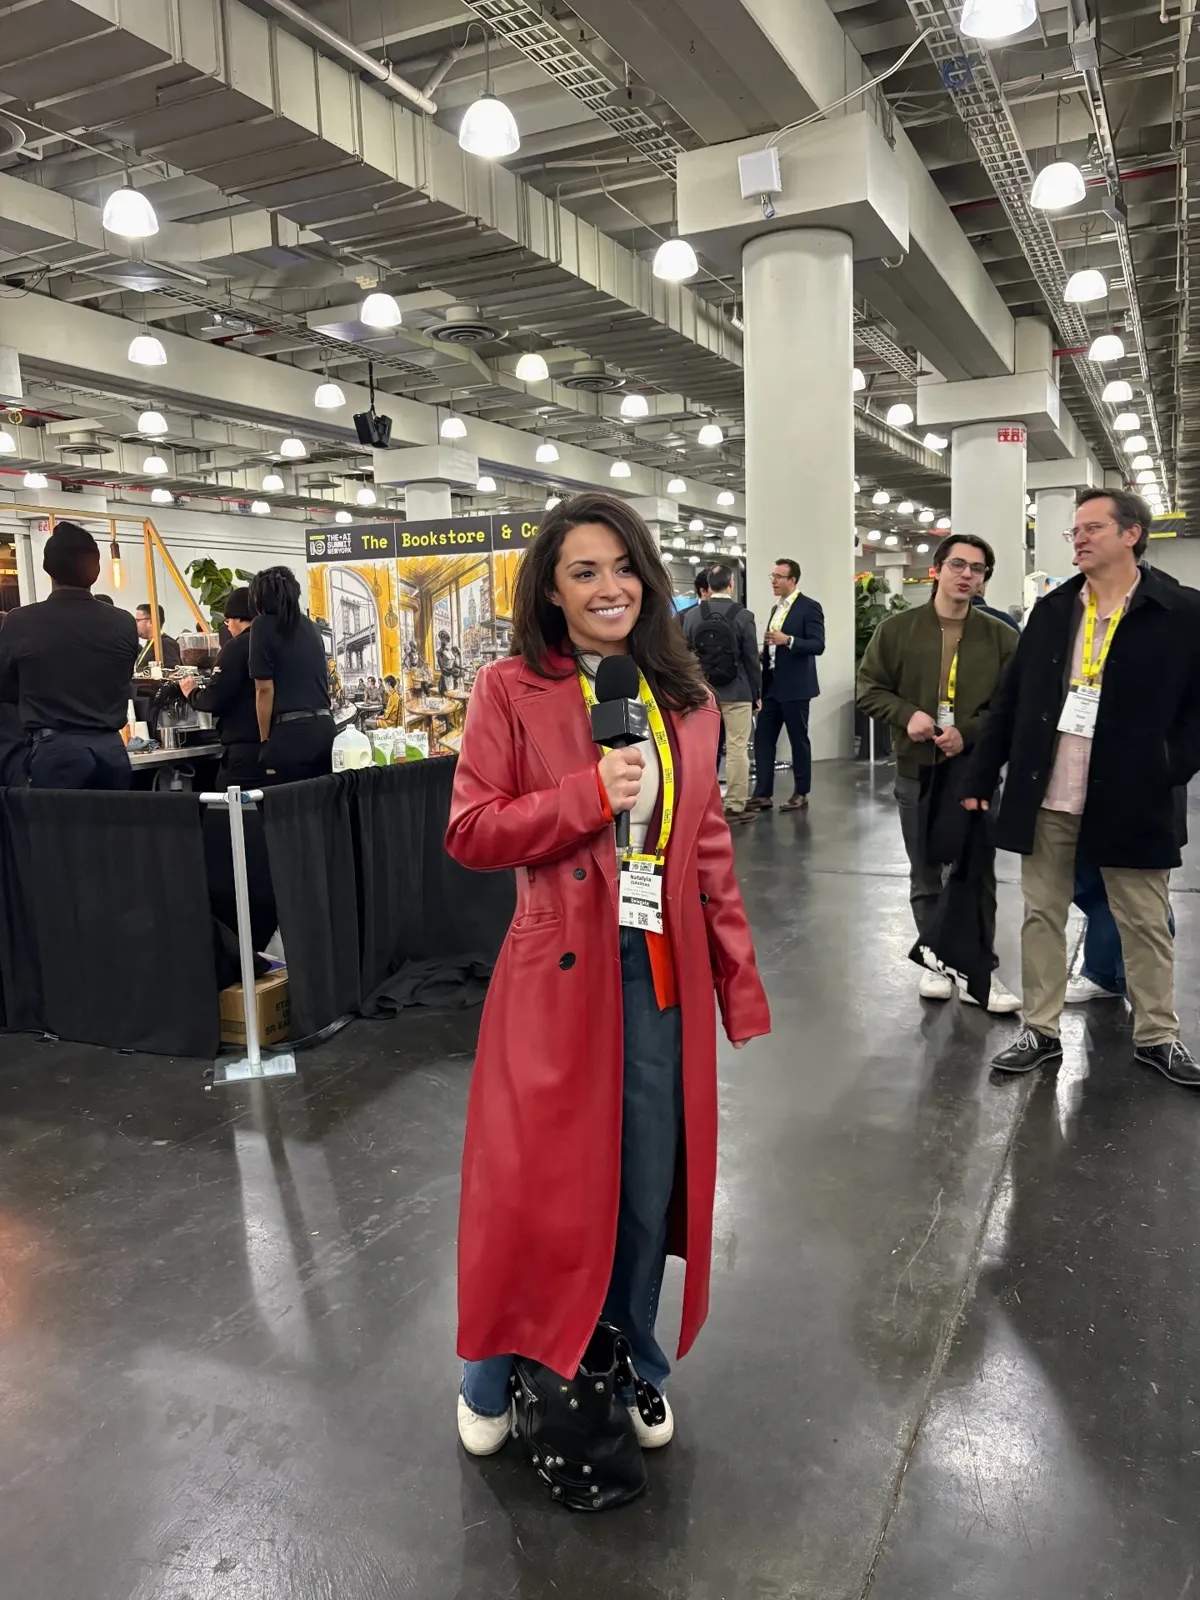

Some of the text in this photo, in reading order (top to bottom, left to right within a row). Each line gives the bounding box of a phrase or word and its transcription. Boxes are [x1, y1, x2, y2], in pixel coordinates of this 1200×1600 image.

[361, 535, 388, 550] The
[402, 530, 485, 548] Bookstore
[501, 524, 512, 539] &
